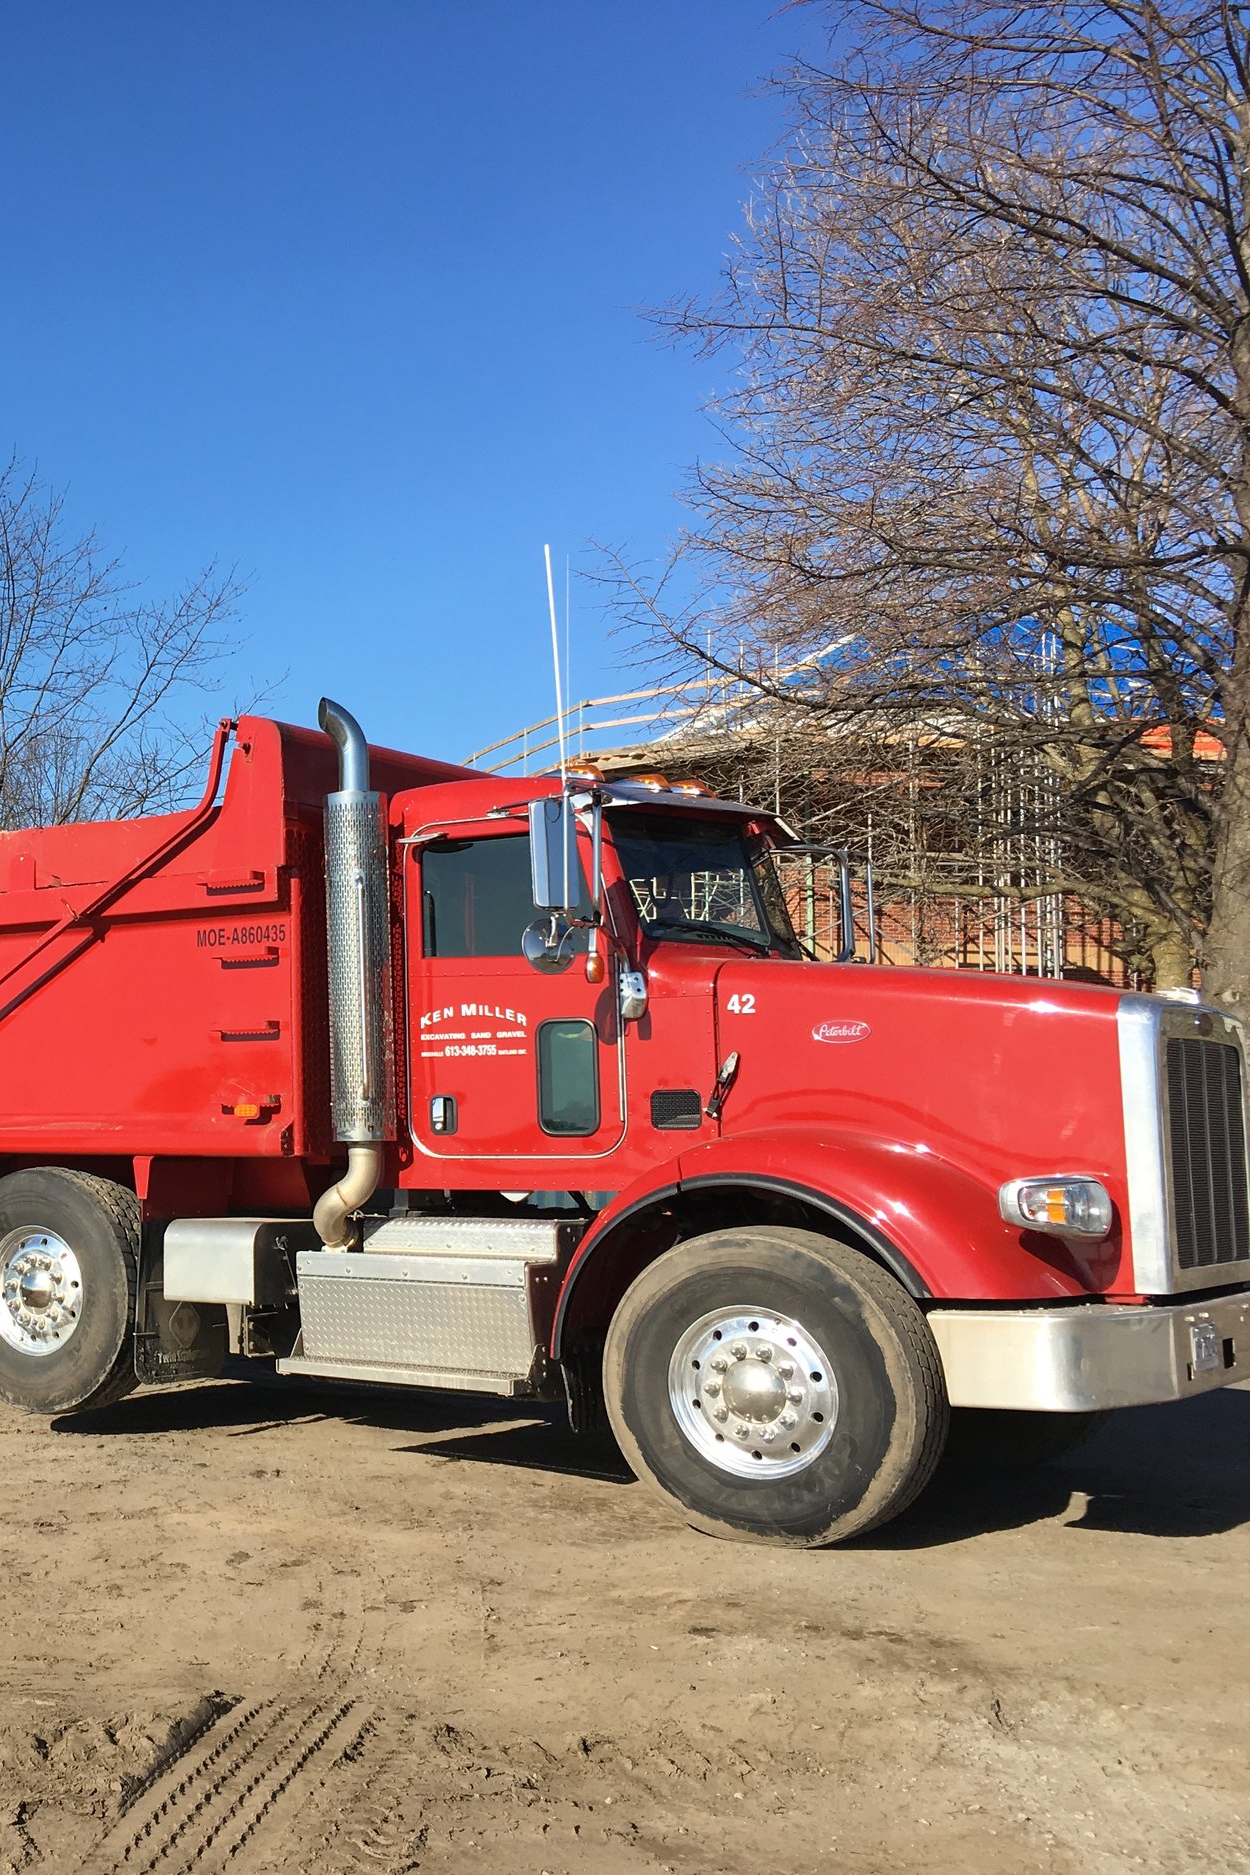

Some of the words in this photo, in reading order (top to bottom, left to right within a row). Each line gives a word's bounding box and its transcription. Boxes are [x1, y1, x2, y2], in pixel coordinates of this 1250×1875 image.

[197, 924, 286, 947] MOE-A860435
[726, 993, 756, 1014] 42
[420, 1006, 454, 1029] KEN
[460, 1003, 527, 1027] MILLER
[420, 1032, 465, 1040] EXCAVATING
[470, 1031, 492, 1039] SAND
[496, 1030, 526, 1038] GRAVEL
[819, 1024, 862, 1038] Peterbilt
[445, 1044, 497, 1057] 613-348-3755
